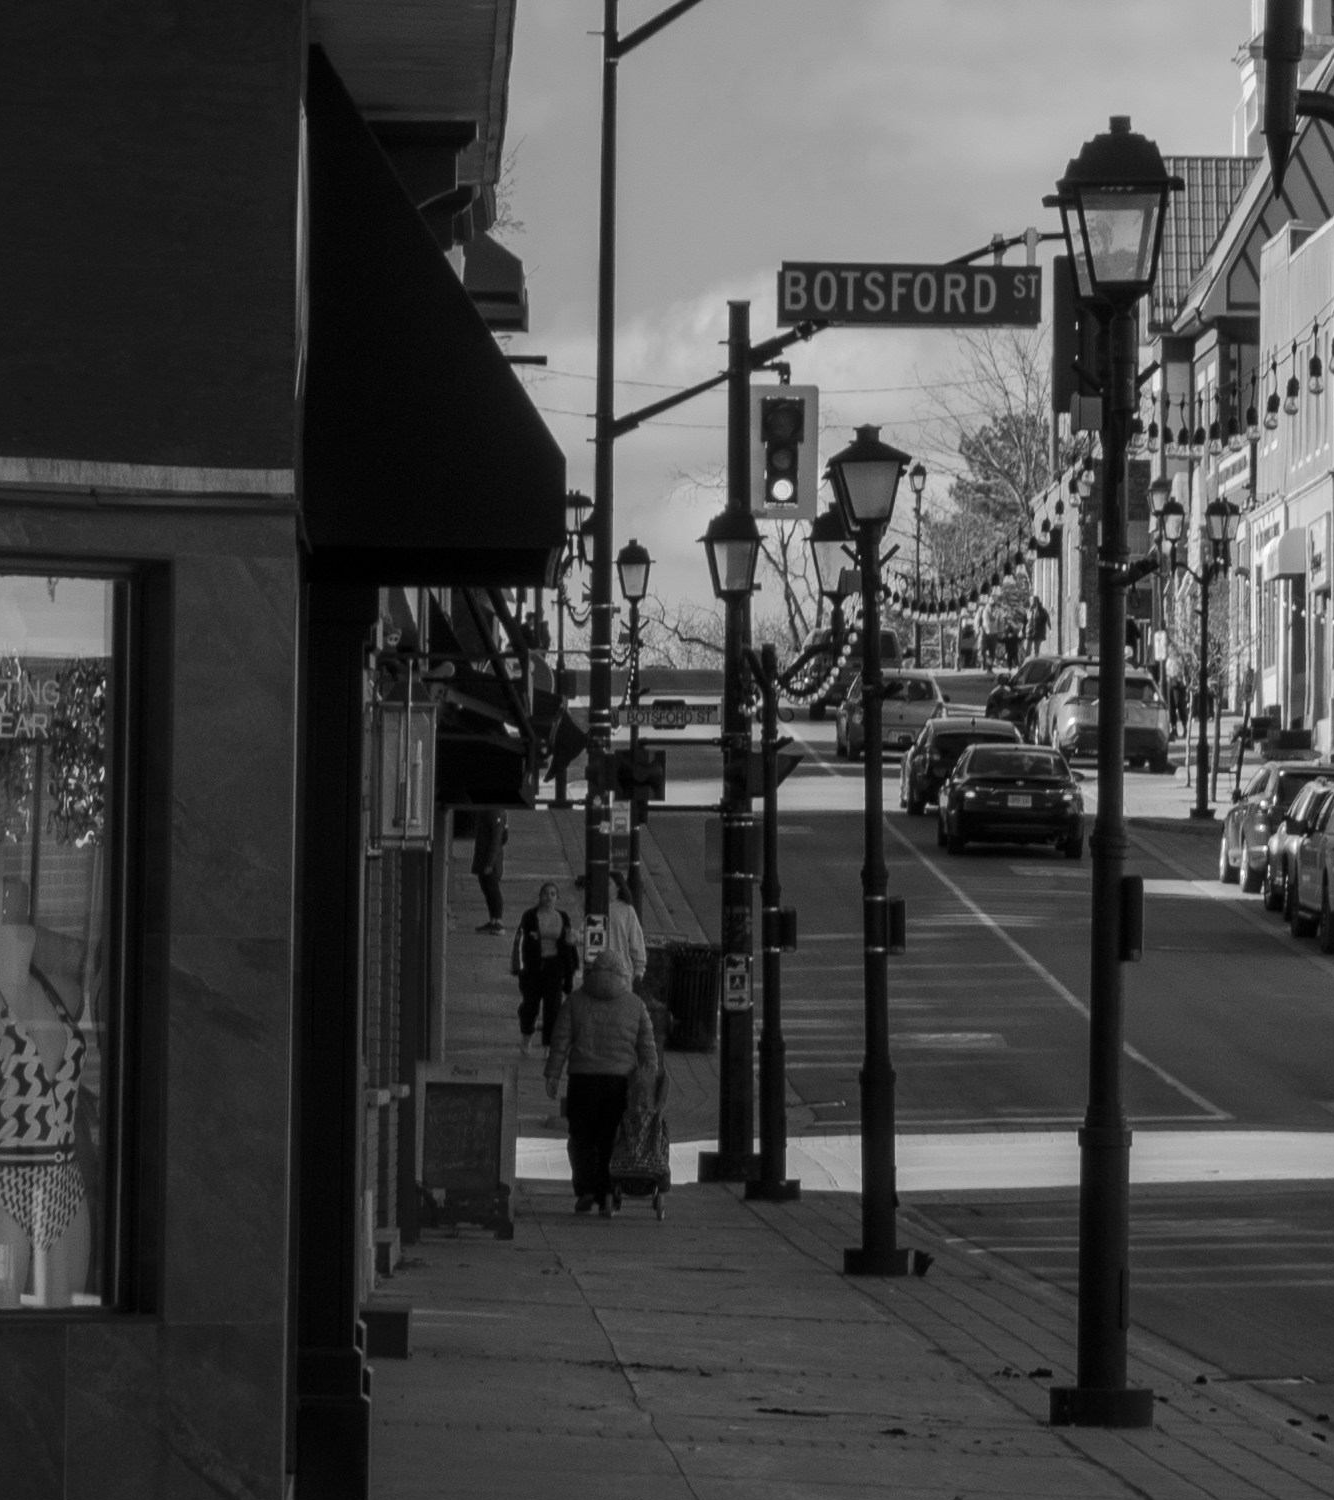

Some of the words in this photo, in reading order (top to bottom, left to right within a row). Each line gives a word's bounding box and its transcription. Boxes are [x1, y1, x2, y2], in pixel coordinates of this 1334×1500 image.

[784, 269, 997, 313] BOTSFORD
[1012, 274, 1039, 299] ST
[626, 710, 693, 724] BOTSFORD
[696, 710, 712, 724] ST
